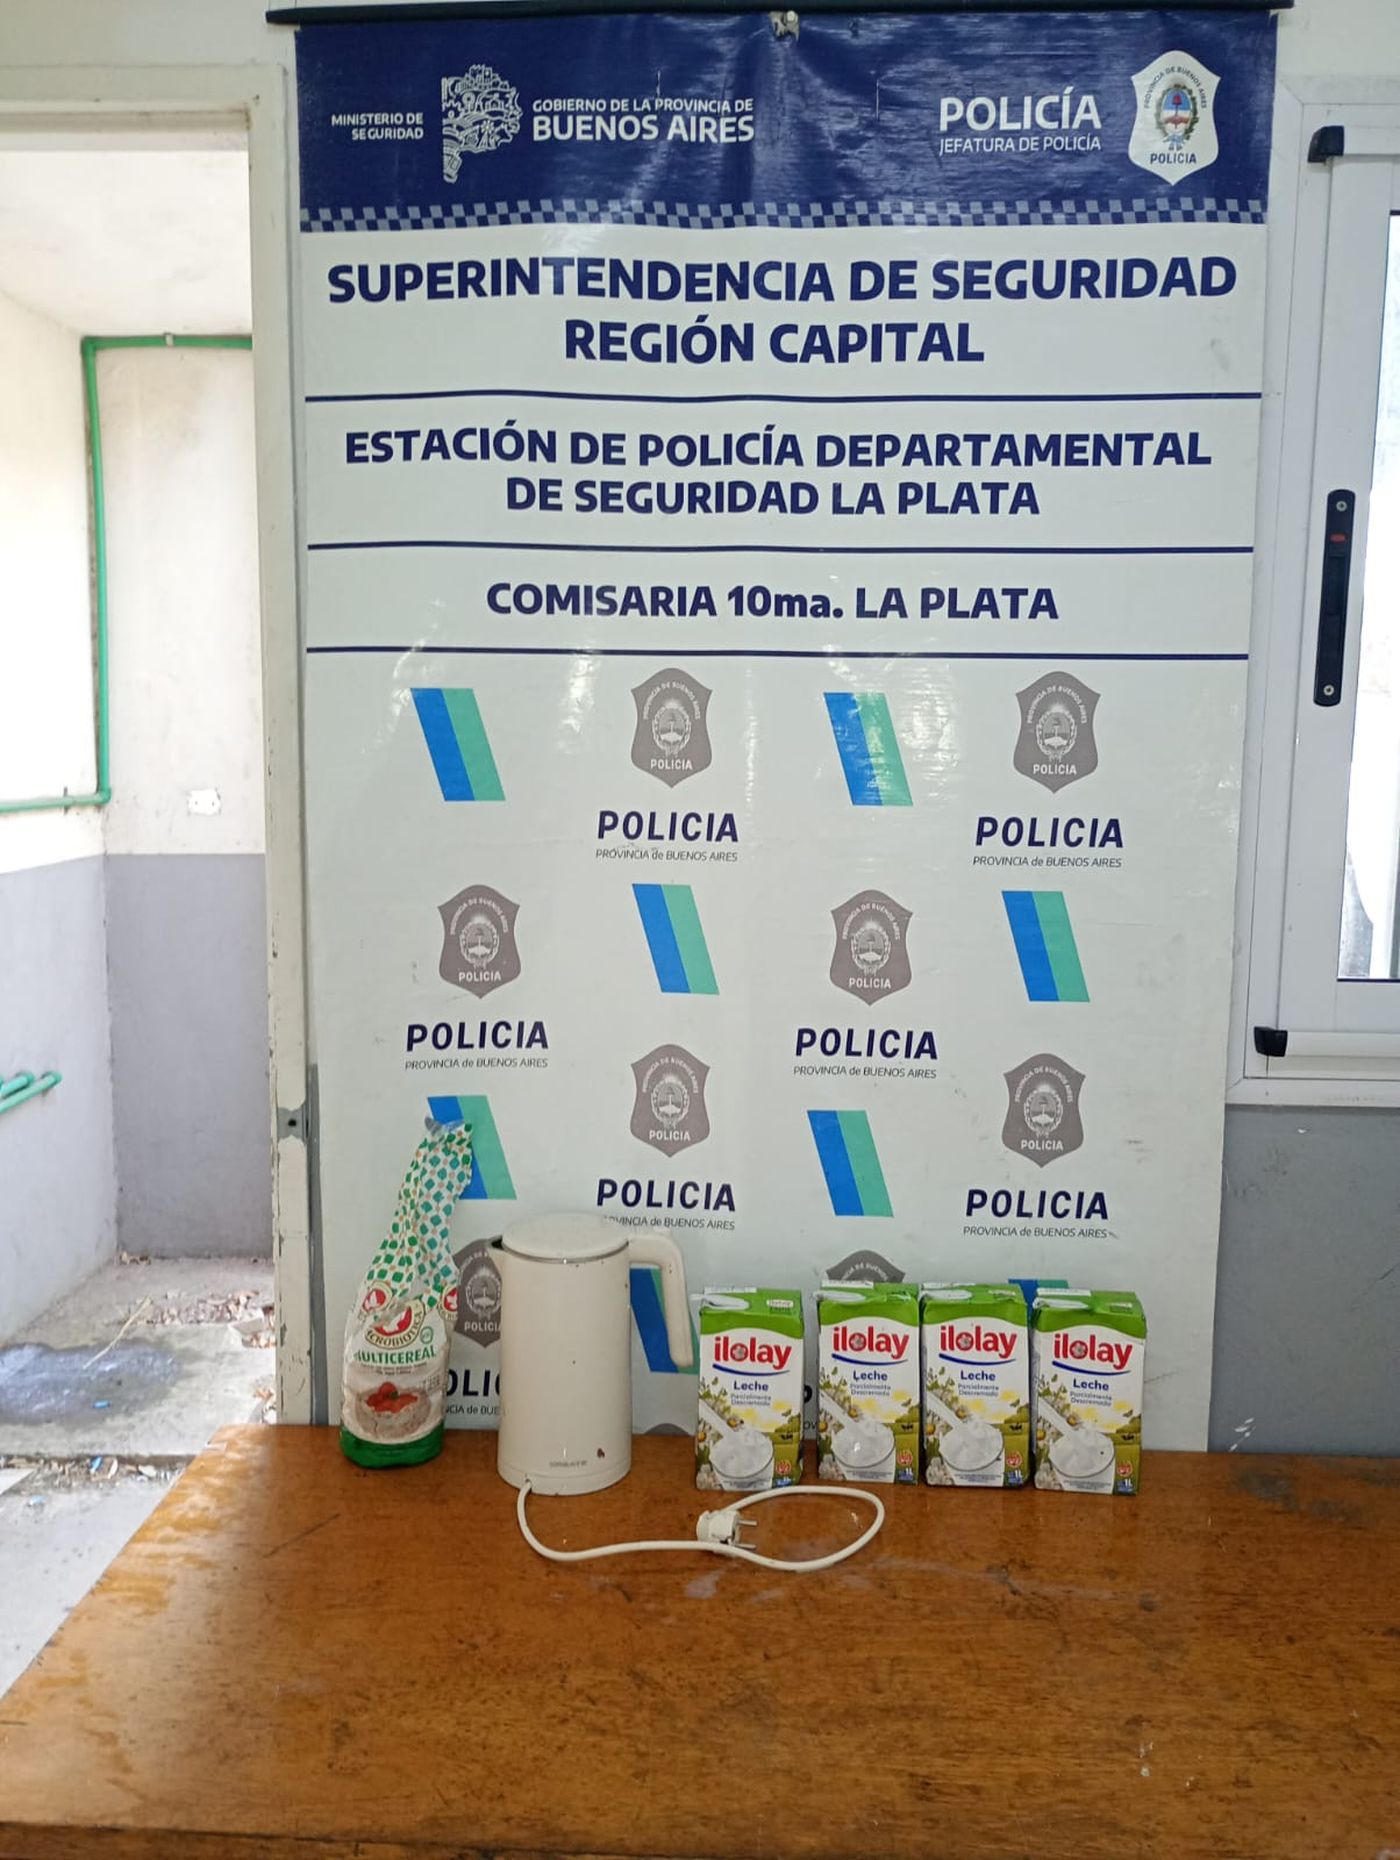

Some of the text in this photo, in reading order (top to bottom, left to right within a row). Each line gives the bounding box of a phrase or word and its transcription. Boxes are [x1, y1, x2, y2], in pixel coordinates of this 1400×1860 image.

[532, 98, 754, 115] GOBIERNO DE LA PROVINCIA DE
[940, 86, 1101, 131] POLICÍA
[331, 112, 424, 127] MINISTERIO DE
[351, 127, 424, 141] SEGURIDAD
[534, 115, 754, 143] BUENOS AIRES
[940, 133, 1101, 155] JEFATURA DE POLICÍA
[1149, 152, 1197, 165] POLICIA
[328, 257, 1236, 303] SUPERINTENDENCIA DE SEGURIDAD
[566, 314, 984, 364] REGIÓN CAPITAL
[346, 420, 1211, 467] ESTACIÓN DE POLICÍA DEPARTAMENTAL
[507, 477, 1039, 514] DE SEGURIDAD LA PLATA
[487, 583, 1058, 619] COMISARIA 10ma. LA PLATA
[650, 758, 693, 771] POLICIA
[1032, 763, 1078, 775] POLICIA
[598, 811, 738, 842] POLICIA
[976, 817, 1123, 848] POLICIA
[595, 847, 738, 863] PROVINCIA de BUENOS AIRES
[972, 855, 1122, 868] PROVINCIA de BUENOS AIRES
[458, 970, 502, 983] POLICIA
[848, 977, 892, 989] POLICIA
[407, 1021, 548, 1052] POLICIA
[796, 1028, 937, 1060] POLICIA
[404, 1057, 548, 1070] PROVINCIA de BUENOS AIRES
[793, 1065, 937, 1079] PROVINCIA de BUENOS AIRES
[648, 1129, 691, 1142] POLICIA
[1020, 1139, 1064, 1151] POLICIA
[597, 1179, 735, 1211] POLICIA
[966, 1189, 1108, 1219] POLICIA
[649, 1217, 662, 1227] de
[663, 1217, 705, 1229] BUENOS
[706, 1219, 735, 1231] AIRES
[963, 1225, 1108, 1239] PROVINCIA de BUENOS AIRES
[833, 1326, 910, 1359] ilolay
[940, 1325, 1018, 1359] ilolay
[714, 1336, 792, 1371] ilolay
[1054, 1334, 1133, 1370] ilolay
[852, 1370, 888, 1383] Leche
[960, 1370, 996, 1382] Leche
[733, 1380, 769, 1392] Leche
[1072, 1378, 1110, 1392] Leche
